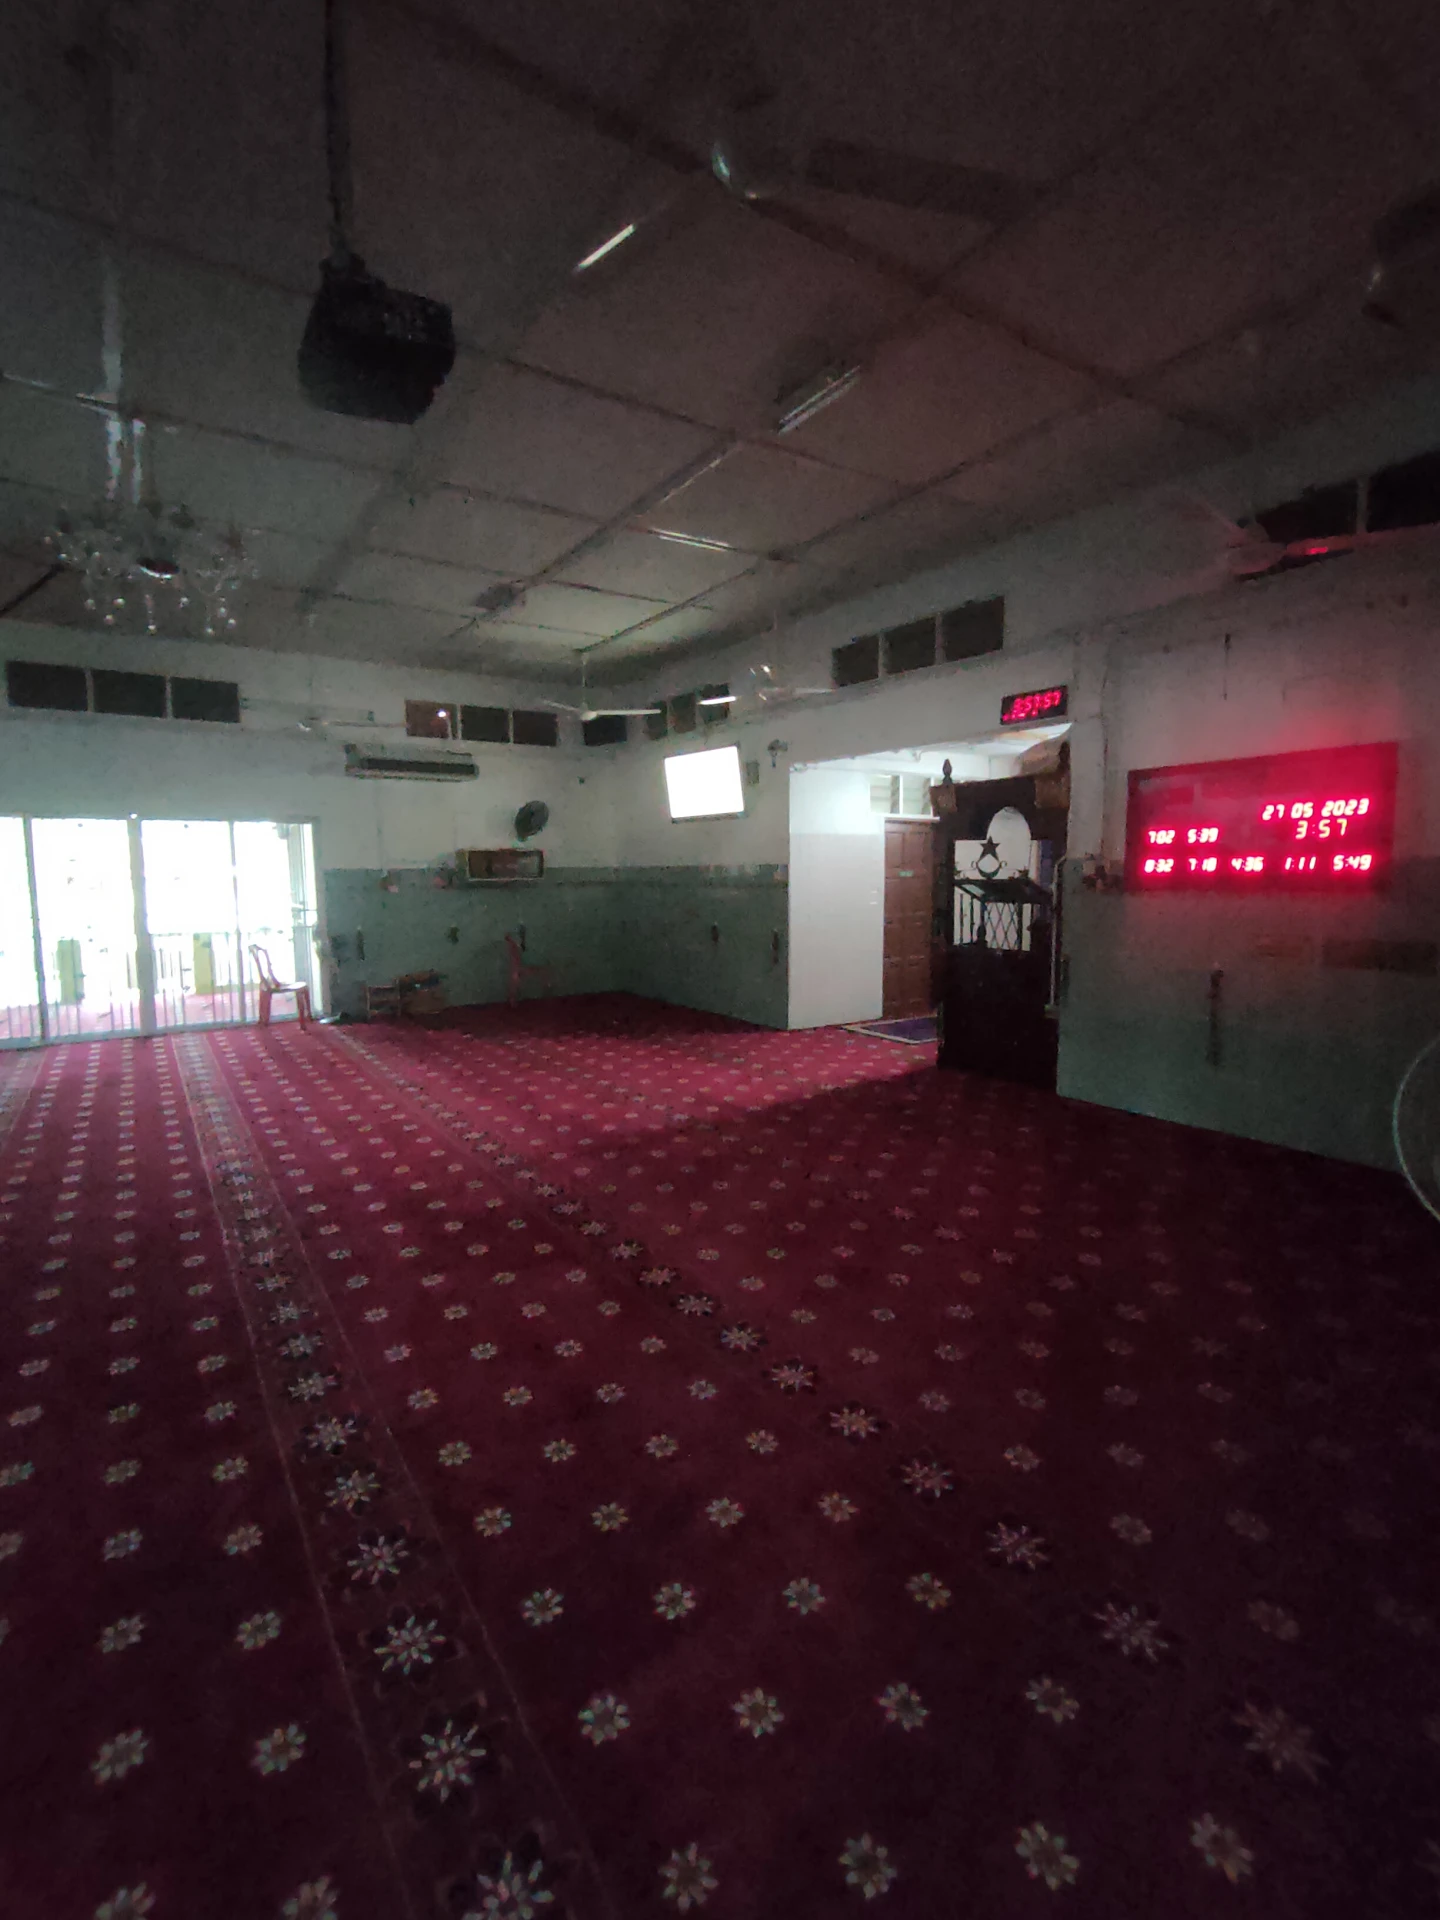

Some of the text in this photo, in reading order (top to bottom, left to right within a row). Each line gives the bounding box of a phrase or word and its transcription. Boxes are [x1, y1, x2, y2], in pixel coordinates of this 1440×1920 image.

[1262, 798, 1369, 821] 27 05 2023
[1295, 818, 1347, 840] 3:57
[1333, 854, 1372, 871] 5:49
